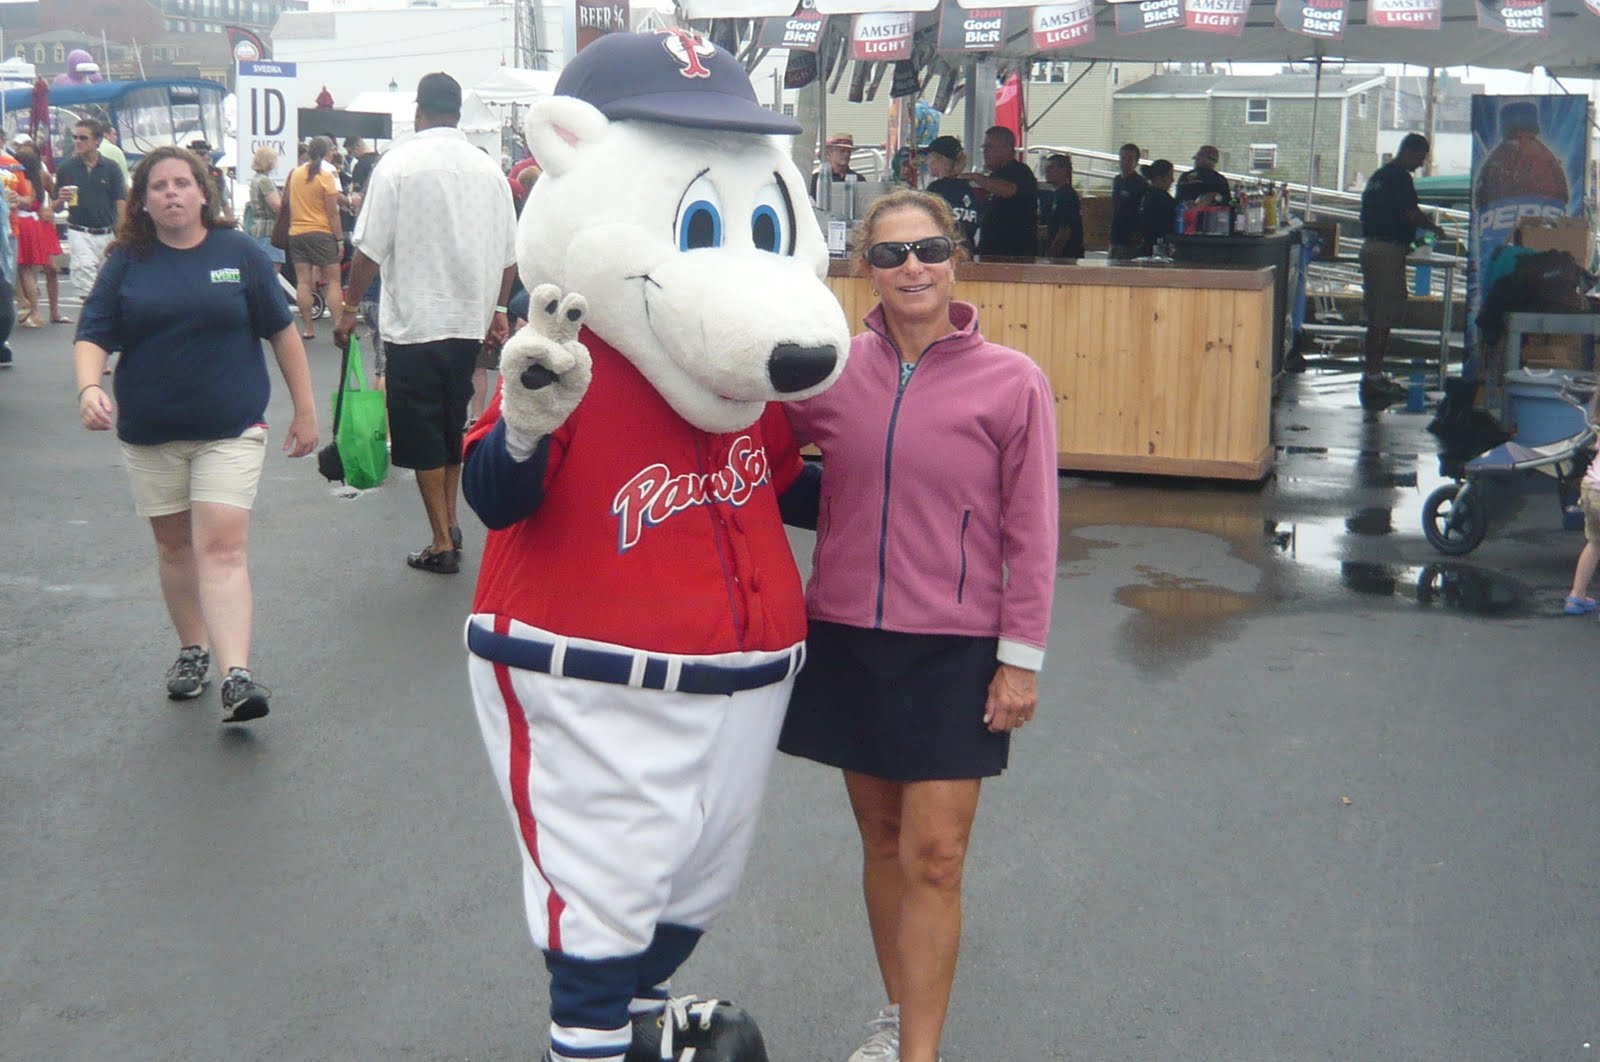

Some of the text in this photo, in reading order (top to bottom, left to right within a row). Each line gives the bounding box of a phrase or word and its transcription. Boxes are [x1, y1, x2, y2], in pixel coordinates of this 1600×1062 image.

[1140, 0, 1178, 11] Good
[1501, 6, 1543, 17] Good
[580, 6, 611, 30] BEER
[1194, 13, 1239, 26] LIGHT
[1302, 7, 1343, 21] Good
[1386, 11, 1433, 21] LIGHT
[786, 20, 821, 31] Good
[963, 19, 1002, 31] Good
[1046, 24, 1089, 43] LIGHT
[865, 40, 906, 53] LIGHT
[251, 87, 286, 136] ID
[1478, 203, 1564, 236] PEP
[610, 435, 772, 555] PawSo
